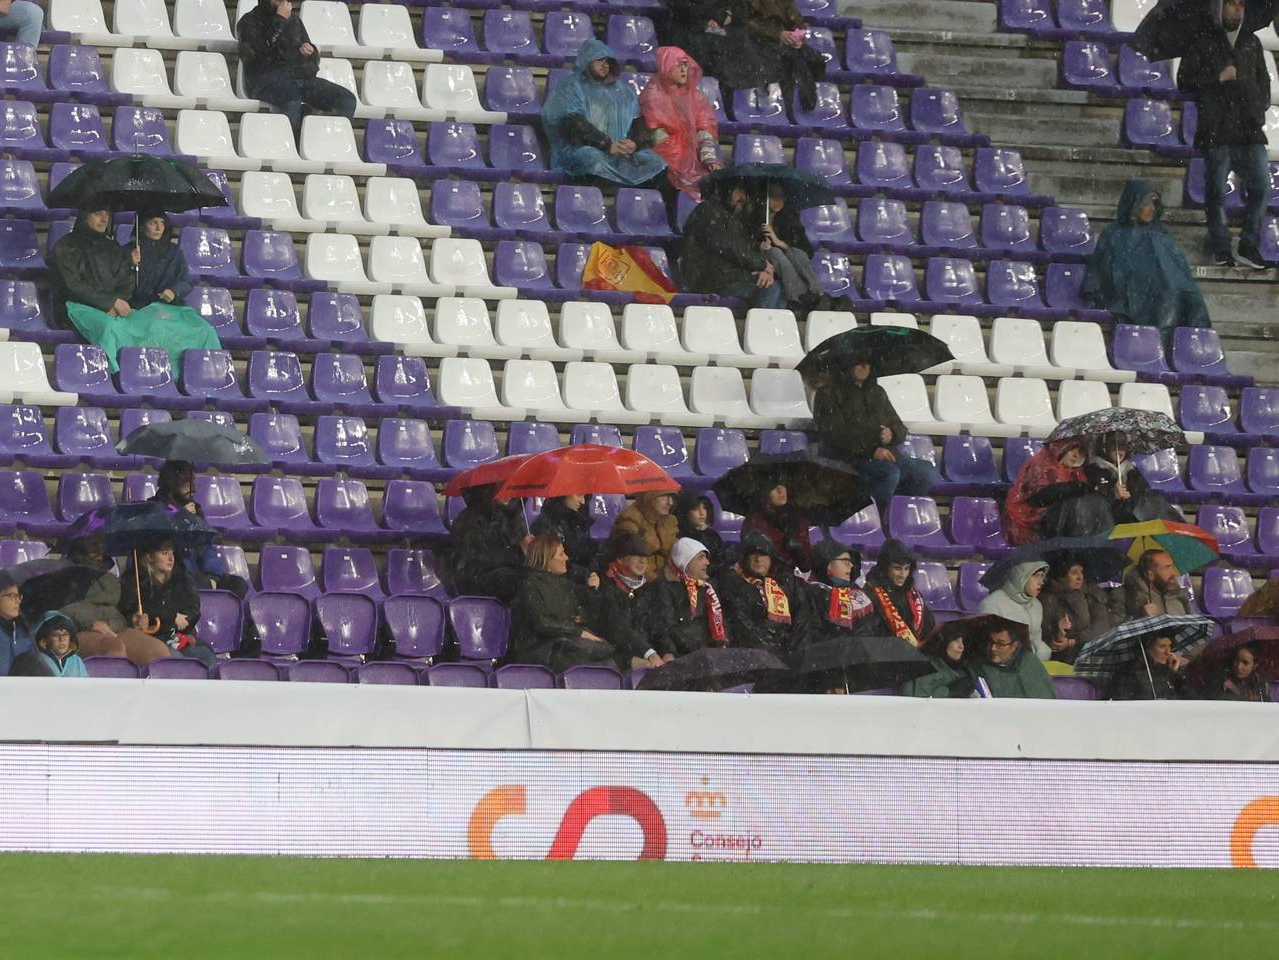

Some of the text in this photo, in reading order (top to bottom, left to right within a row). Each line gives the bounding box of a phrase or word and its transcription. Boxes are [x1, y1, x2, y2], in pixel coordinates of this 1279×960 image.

[940, 32, 952, 41] 14
[1196, 267, 1207, 277] 10
[690, 829, 762, 852] Consejo
